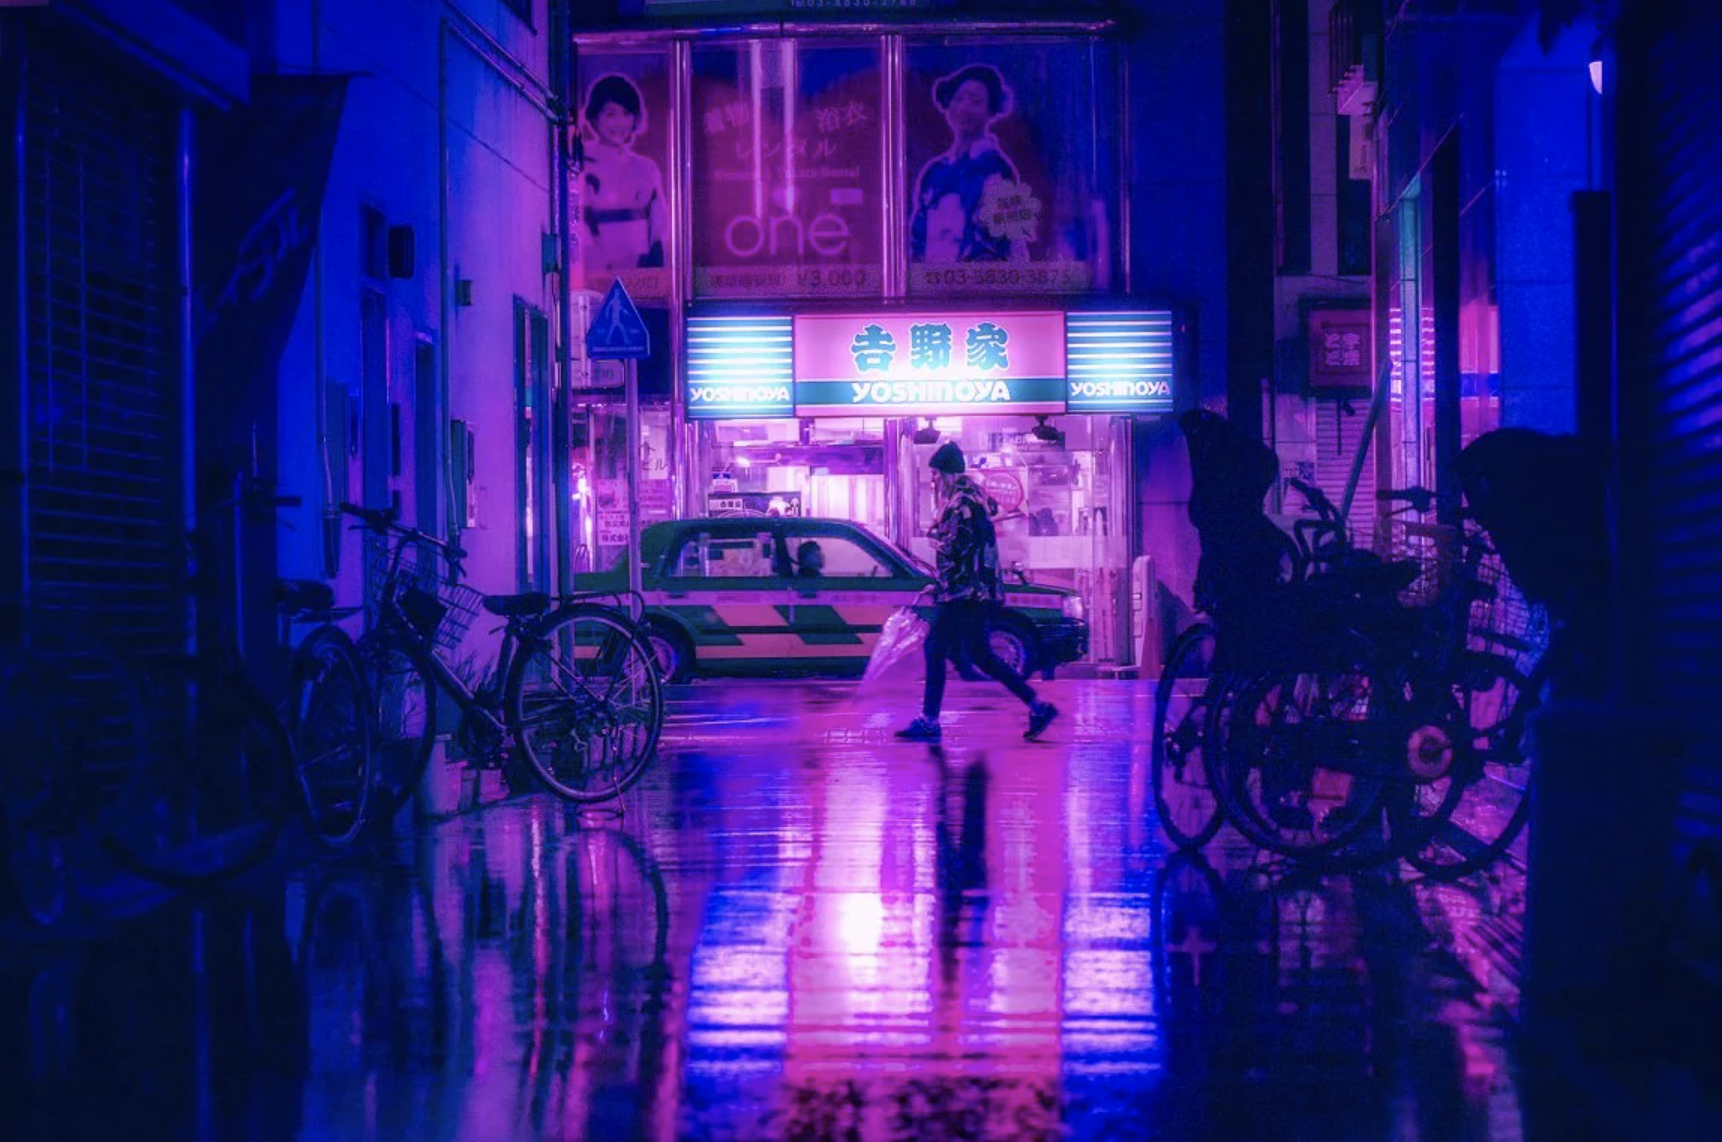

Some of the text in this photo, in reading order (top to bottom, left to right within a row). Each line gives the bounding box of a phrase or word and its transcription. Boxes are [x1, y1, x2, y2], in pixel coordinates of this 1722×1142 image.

[724, 213, 850, 257] one
[851, 322, 1009, 372] 吉野家
